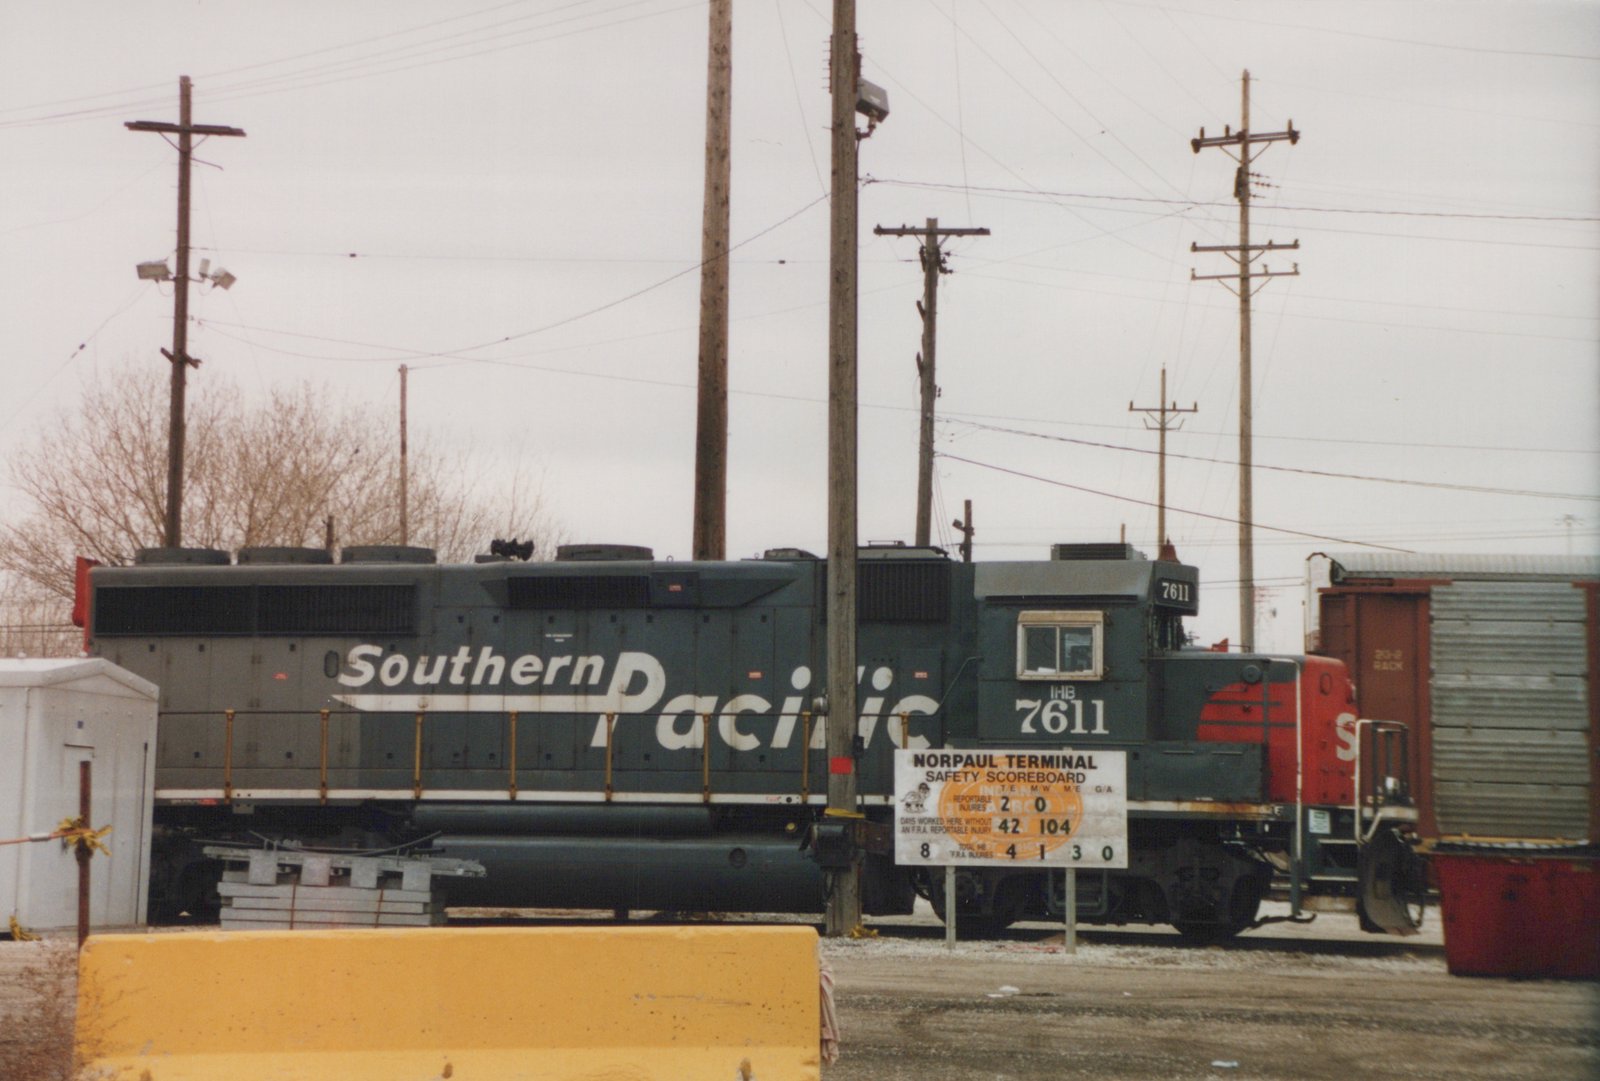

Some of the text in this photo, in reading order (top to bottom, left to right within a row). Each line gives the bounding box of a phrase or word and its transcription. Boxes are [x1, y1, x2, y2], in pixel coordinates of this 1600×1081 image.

[1161, 582, 1190, 602] 7611
[338, 644, 606, 687] Southern
[1050, 685, 1076, 700] IHB
[1015, 699, 1110, 735] 7611
[914, 754, 1098, 769] NORPAUL TERMINAL
[925, 770, 1086, 784] SAFETY SCOREBOARD
[1000, 796, 1011, 813] 2
[1034, 796, 1047, 813] 0
[998, 818, 1021, 835] 42
[1039, 818, 1071, 836] 104
[920, 843, 931, 859] 8
[1006, 844, 1017, 859] 4
[1072, 845, 1082, 860] 3
[1102, 846, 1113, 860] 0
